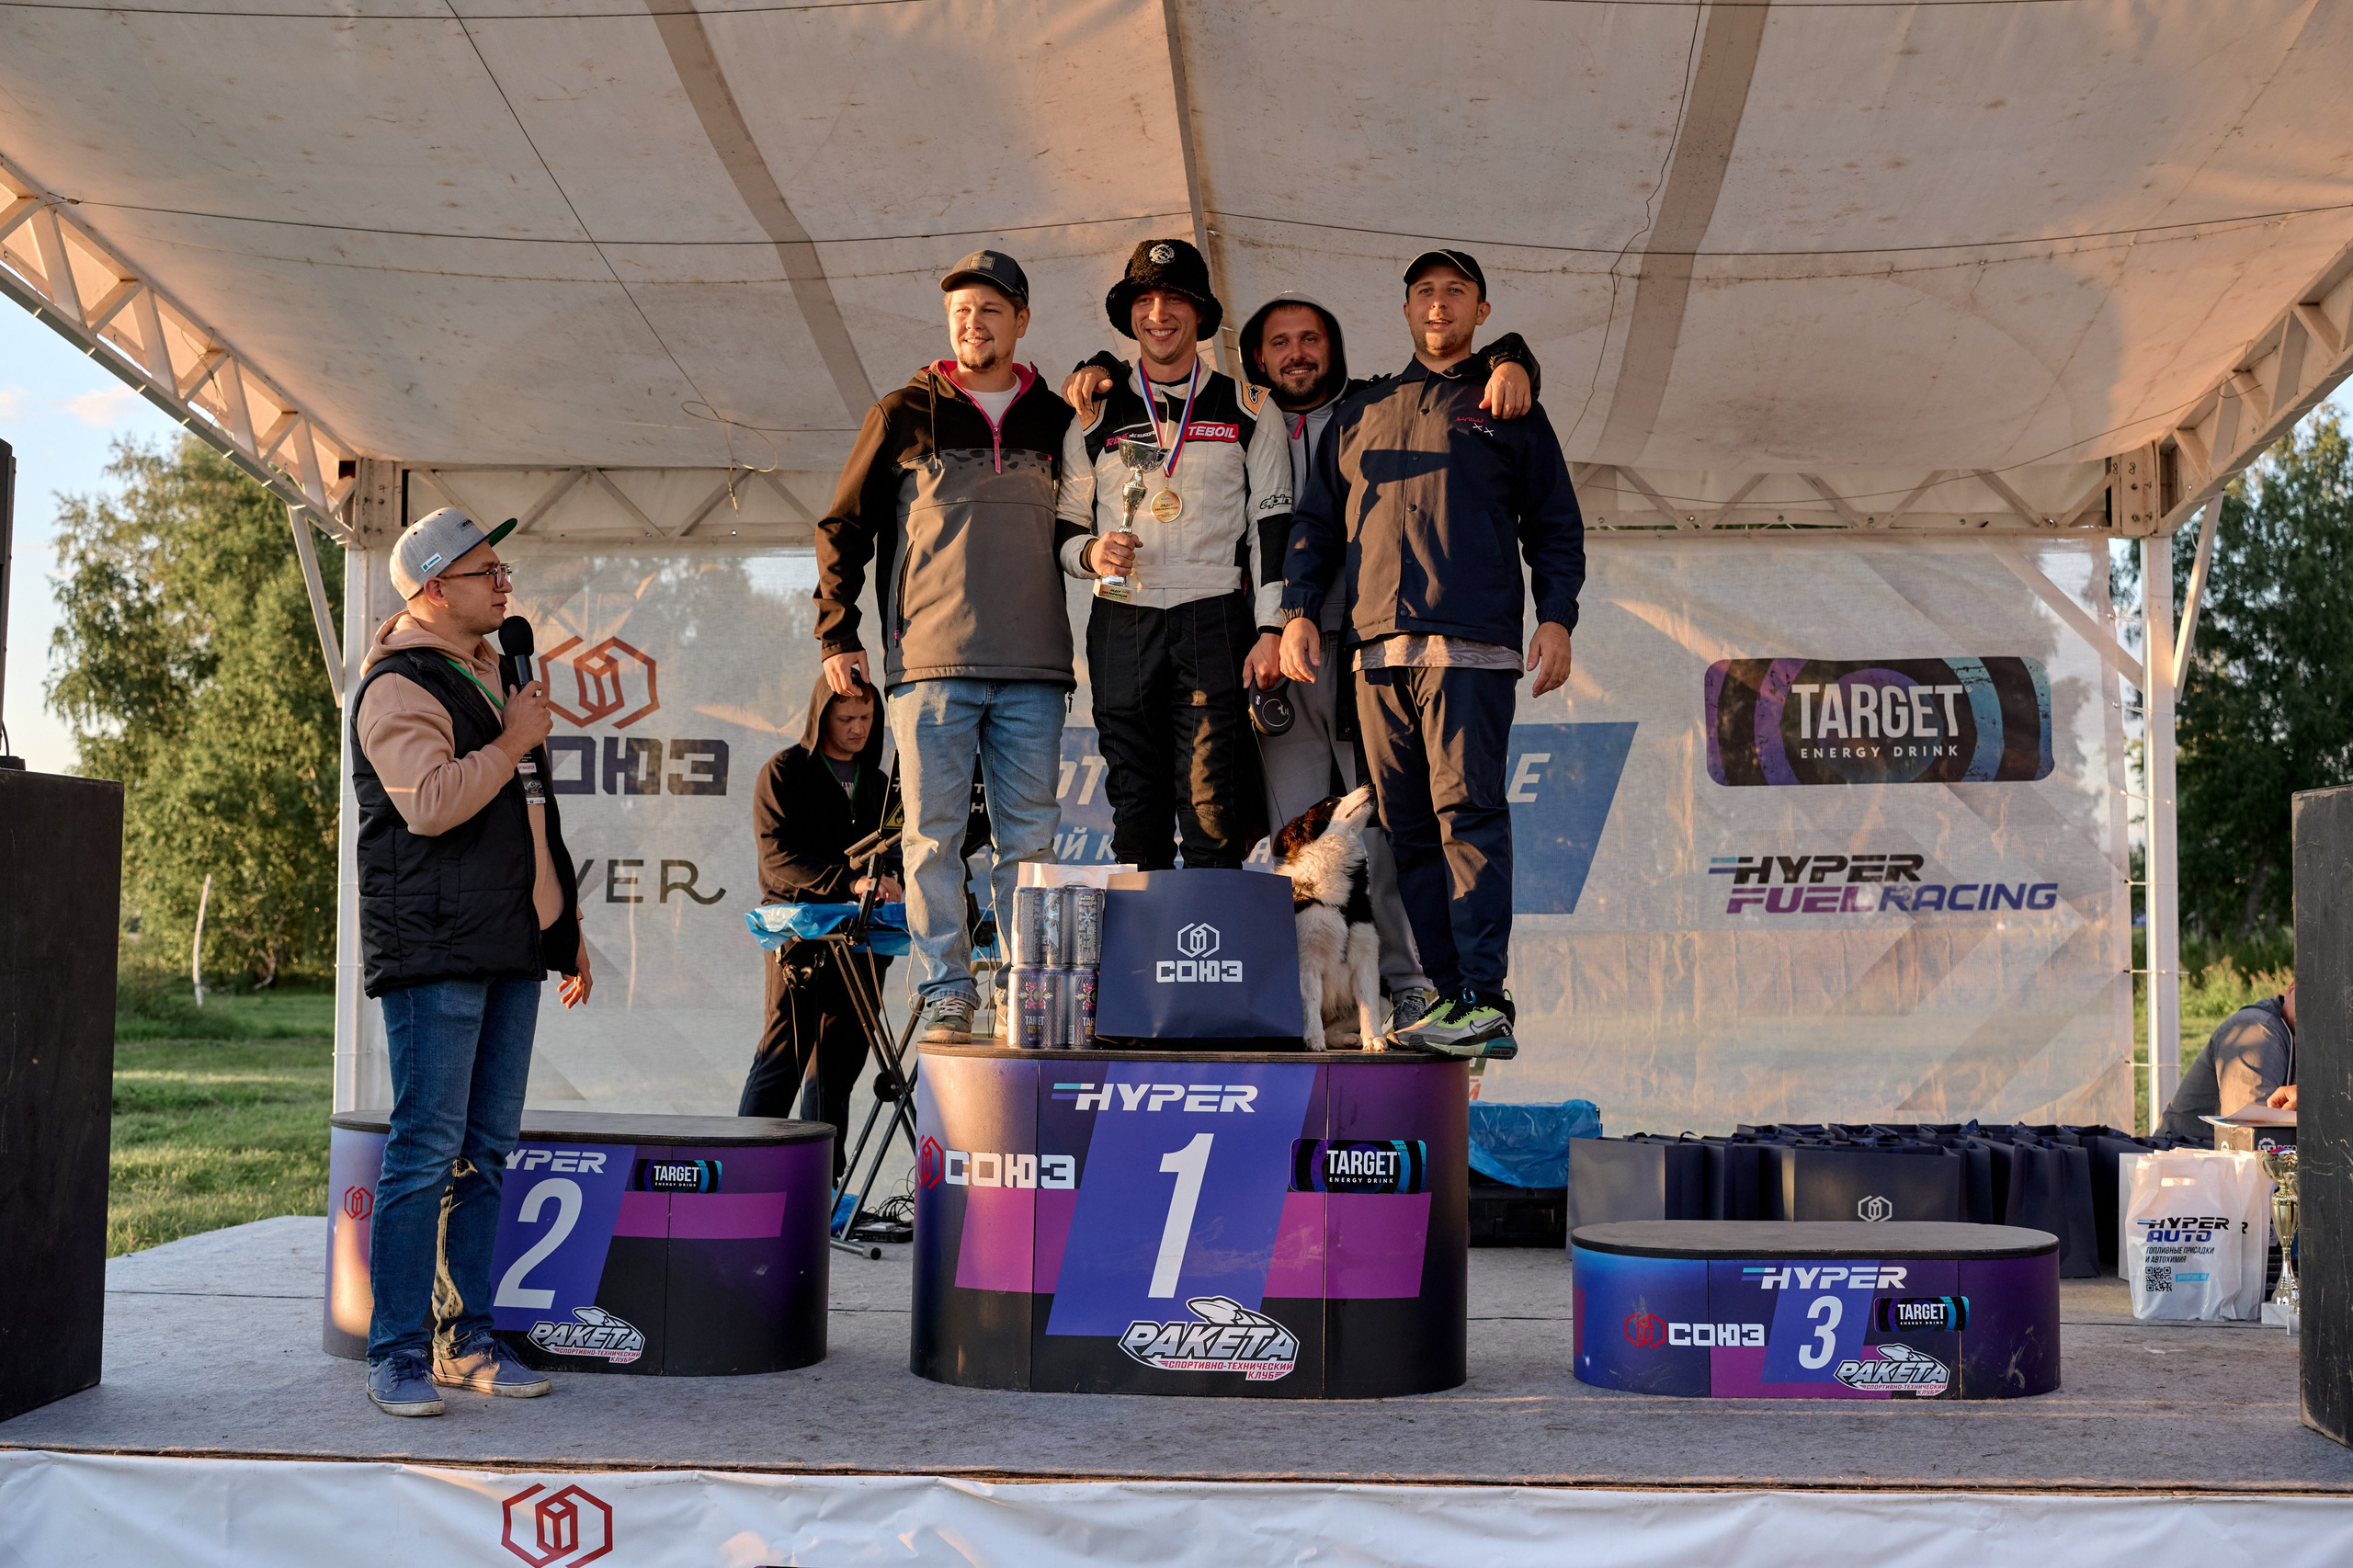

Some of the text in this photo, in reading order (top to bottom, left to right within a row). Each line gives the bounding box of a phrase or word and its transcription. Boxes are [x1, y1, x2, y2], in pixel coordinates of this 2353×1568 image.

[1188, 426, 1236, 438] TEBOIL
[1260, 494, 1292, 509] alpin
[1791, 684, 1963, 739] TARGET
[1801, 744, 1960, 759] ENERGY DRINK
[546, 735, 729, 796] ОЮЗ
[1730, 854, 1925, 885] HYPER
[1155, 960, 1244, 983] СОЮЗ
[1025, 1016, 1045, 1026] TARET
[1072, 1083, 1258, 1114] HYPER
[506, 1149, 608, 1174] YPER
[945, 1151, 1076, 1190] СОЮЗ
[1326, 1150, 1398, 1176] TARGET
[654, 1165, 699, 1183] TARGET
[1148, 1132, 1215, 1299] 1
[2145, 1216, 2230, 1231] HYPER
[493, 1177, 583, 1310] 2
[2146, 1230, 2212, 1243] AUTO
[2144, 1256, 2188, 1264] И АВТОХИМИЯ
[2183, 1246, 2215, 1255] ПРИСАДКИ
[1758, 1267, 1907, 1290] HYPER
[1897, 1303, 1946, 1320] TARGET
[533, 1323, 643, 1351] РАКЕТА
[1123, 1323, 1295, 1359] РАКЕТА
[1667, 1323, 1765, 1346] СОЮЗ
[1798, 1295, 1843, 1369] 3
[559, 1347, 642, 1358] СПОРТИВНО-ТЕХНИЧЕСКИЙ
[1168, 1360, 1293, 1371] СПОРТИВНО-ТЕХНИЧЕСКИЙ
[1247, 1371, 1275, 1380] КЛУБ
[1837, 1361, 1947, 1383] РАКЕТА
